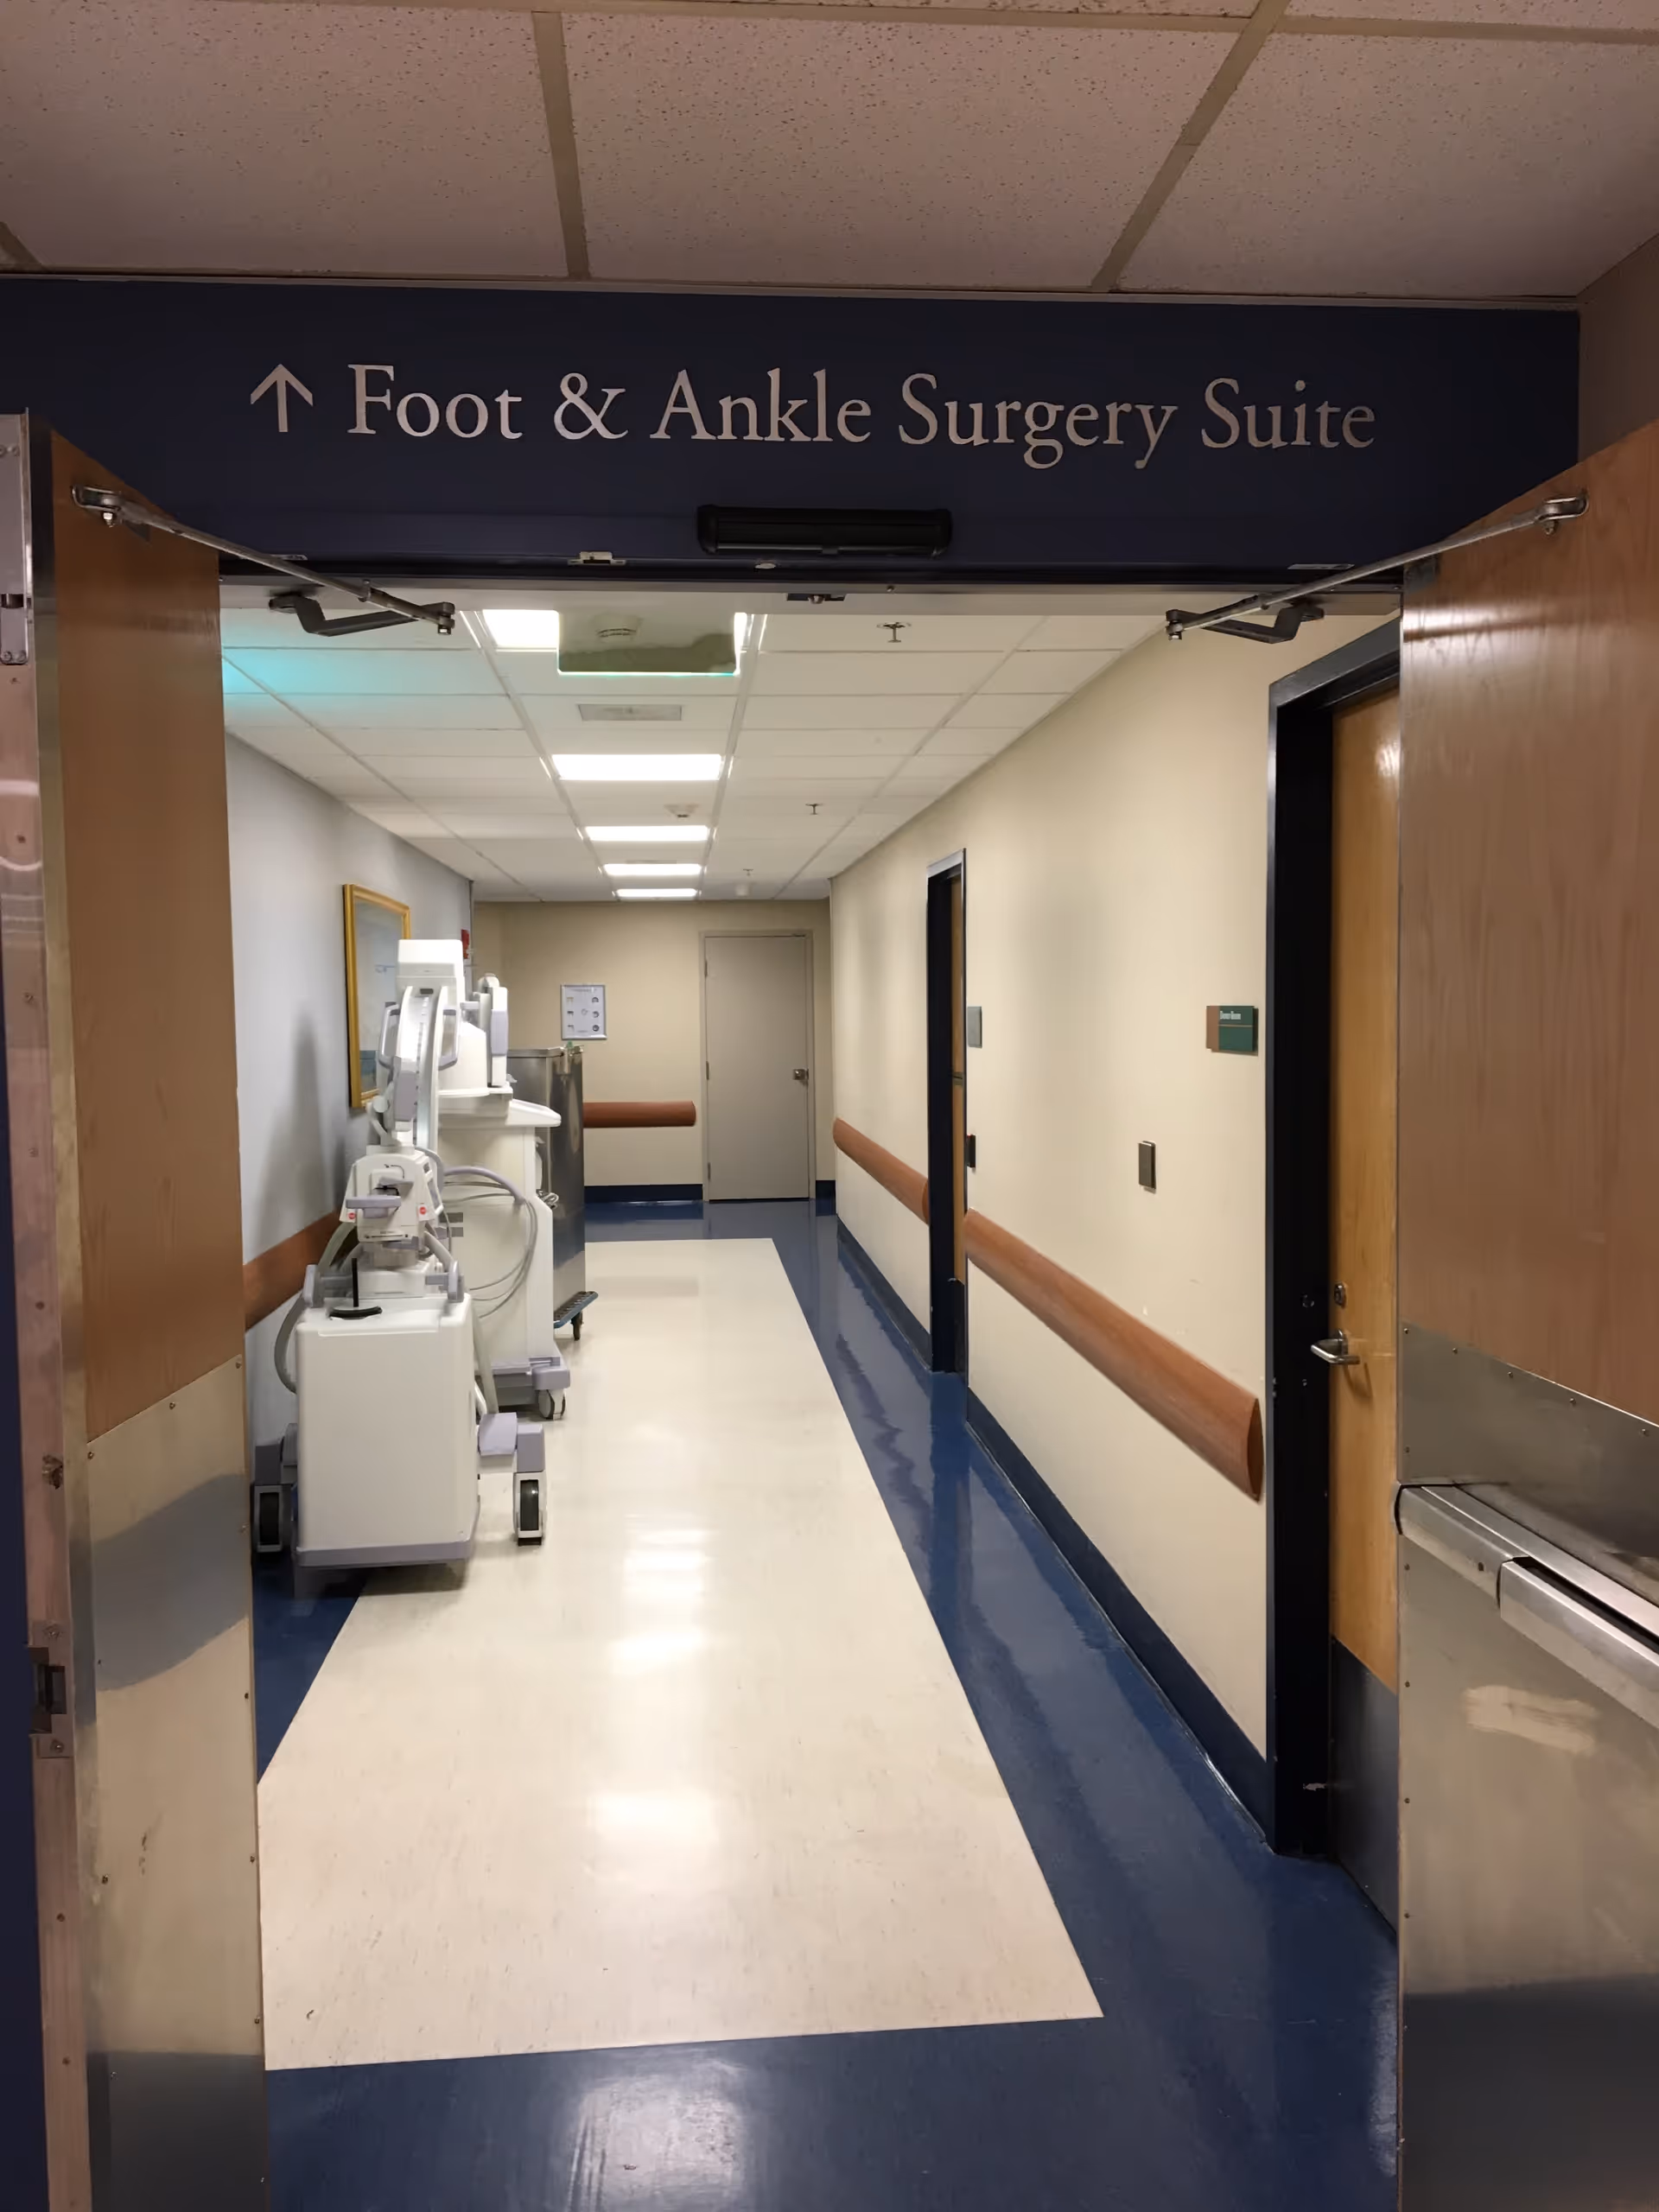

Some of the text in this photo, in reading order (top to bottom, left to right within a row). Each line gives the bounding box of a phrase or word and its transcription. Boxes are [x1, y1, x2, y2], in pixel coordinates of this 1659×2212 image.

[347, 365, 1376, 469] Foot & Ankle Surgery Suite
